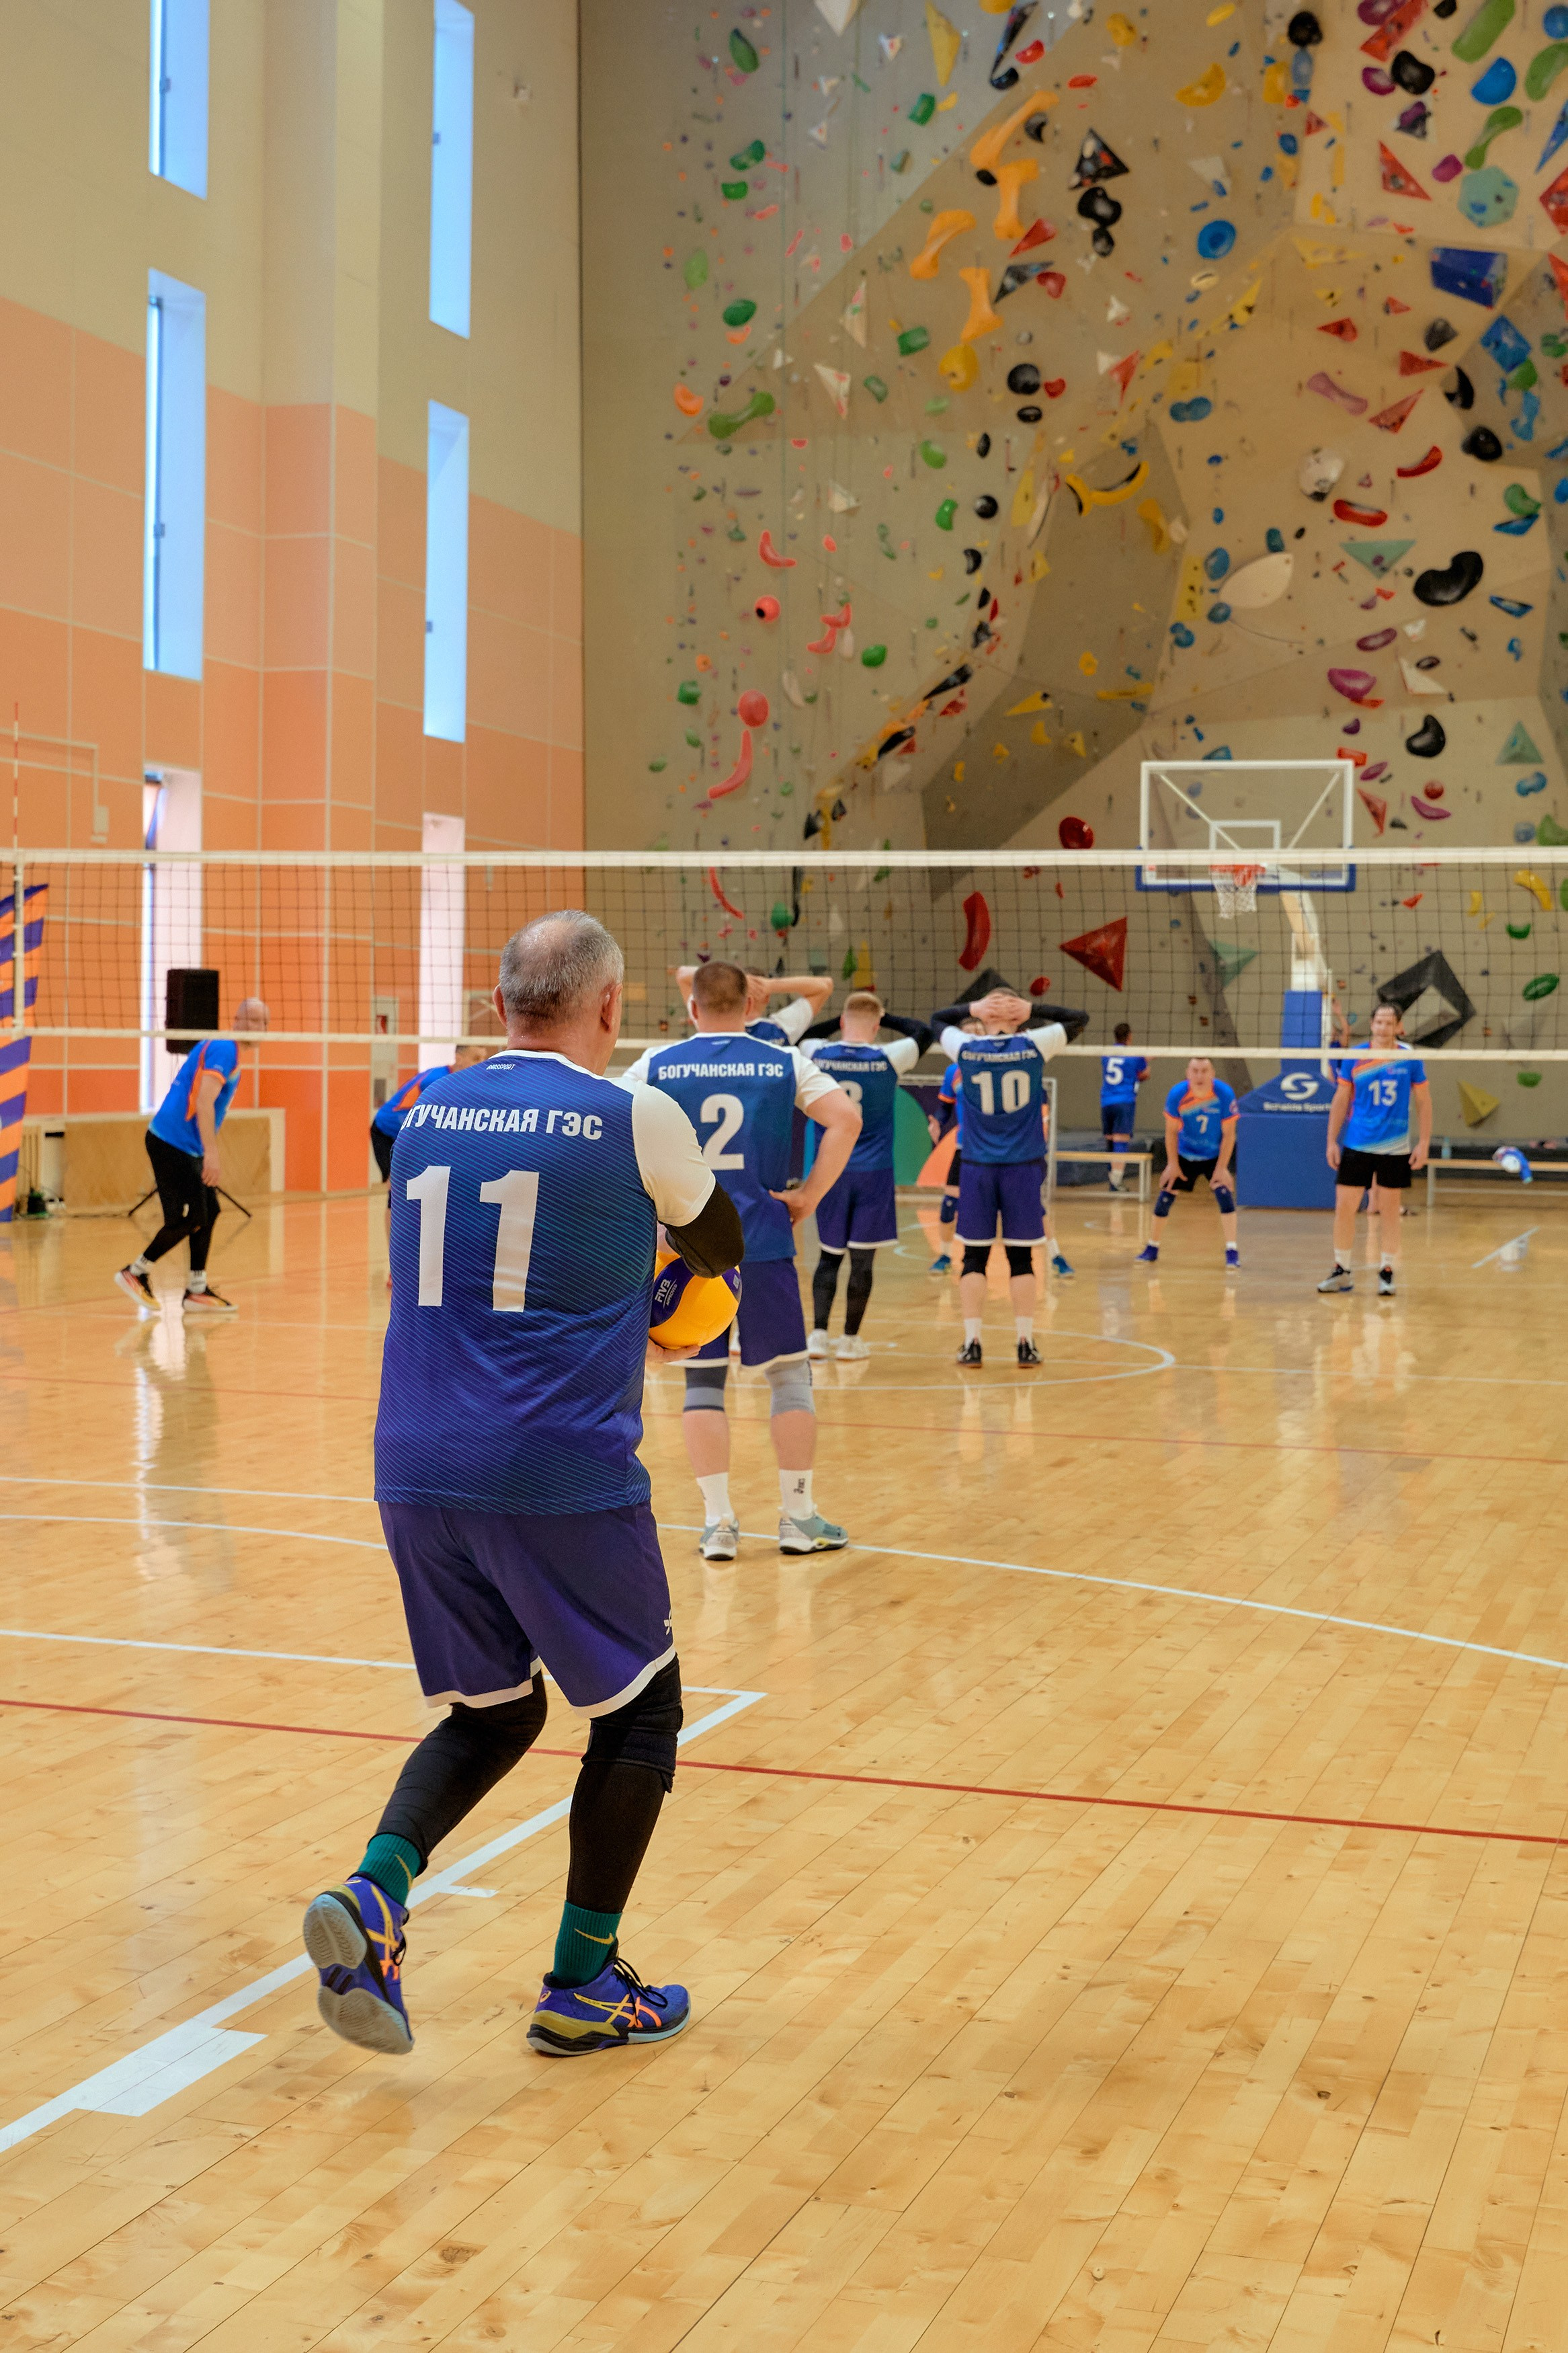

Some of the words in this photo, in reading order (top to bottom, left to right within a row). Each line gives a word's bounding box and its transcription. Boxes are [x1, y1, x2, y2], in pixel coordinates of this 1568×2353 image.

[658, 1063, 755, 1080] БОГУЧАНСКАЯ
[757, 1063, 784, 1077] ГЭС
[1106, 1057, 1124, 1085] 5
[971, 1070, 1030, 1115] 10
[1368, 1080, 1397, 1107] 13
[401, 1104, 538, 1132] ОГУЧАНСКАЯ
[546, 1110, 602, 1140] ГЭС
[700, 1094, 744, 1170] 2
[1196, 1114, 1208, 1134] 7
[407, 1165, 539, 1312] 11
[666, 1283, 677, 1306] APPROVED
